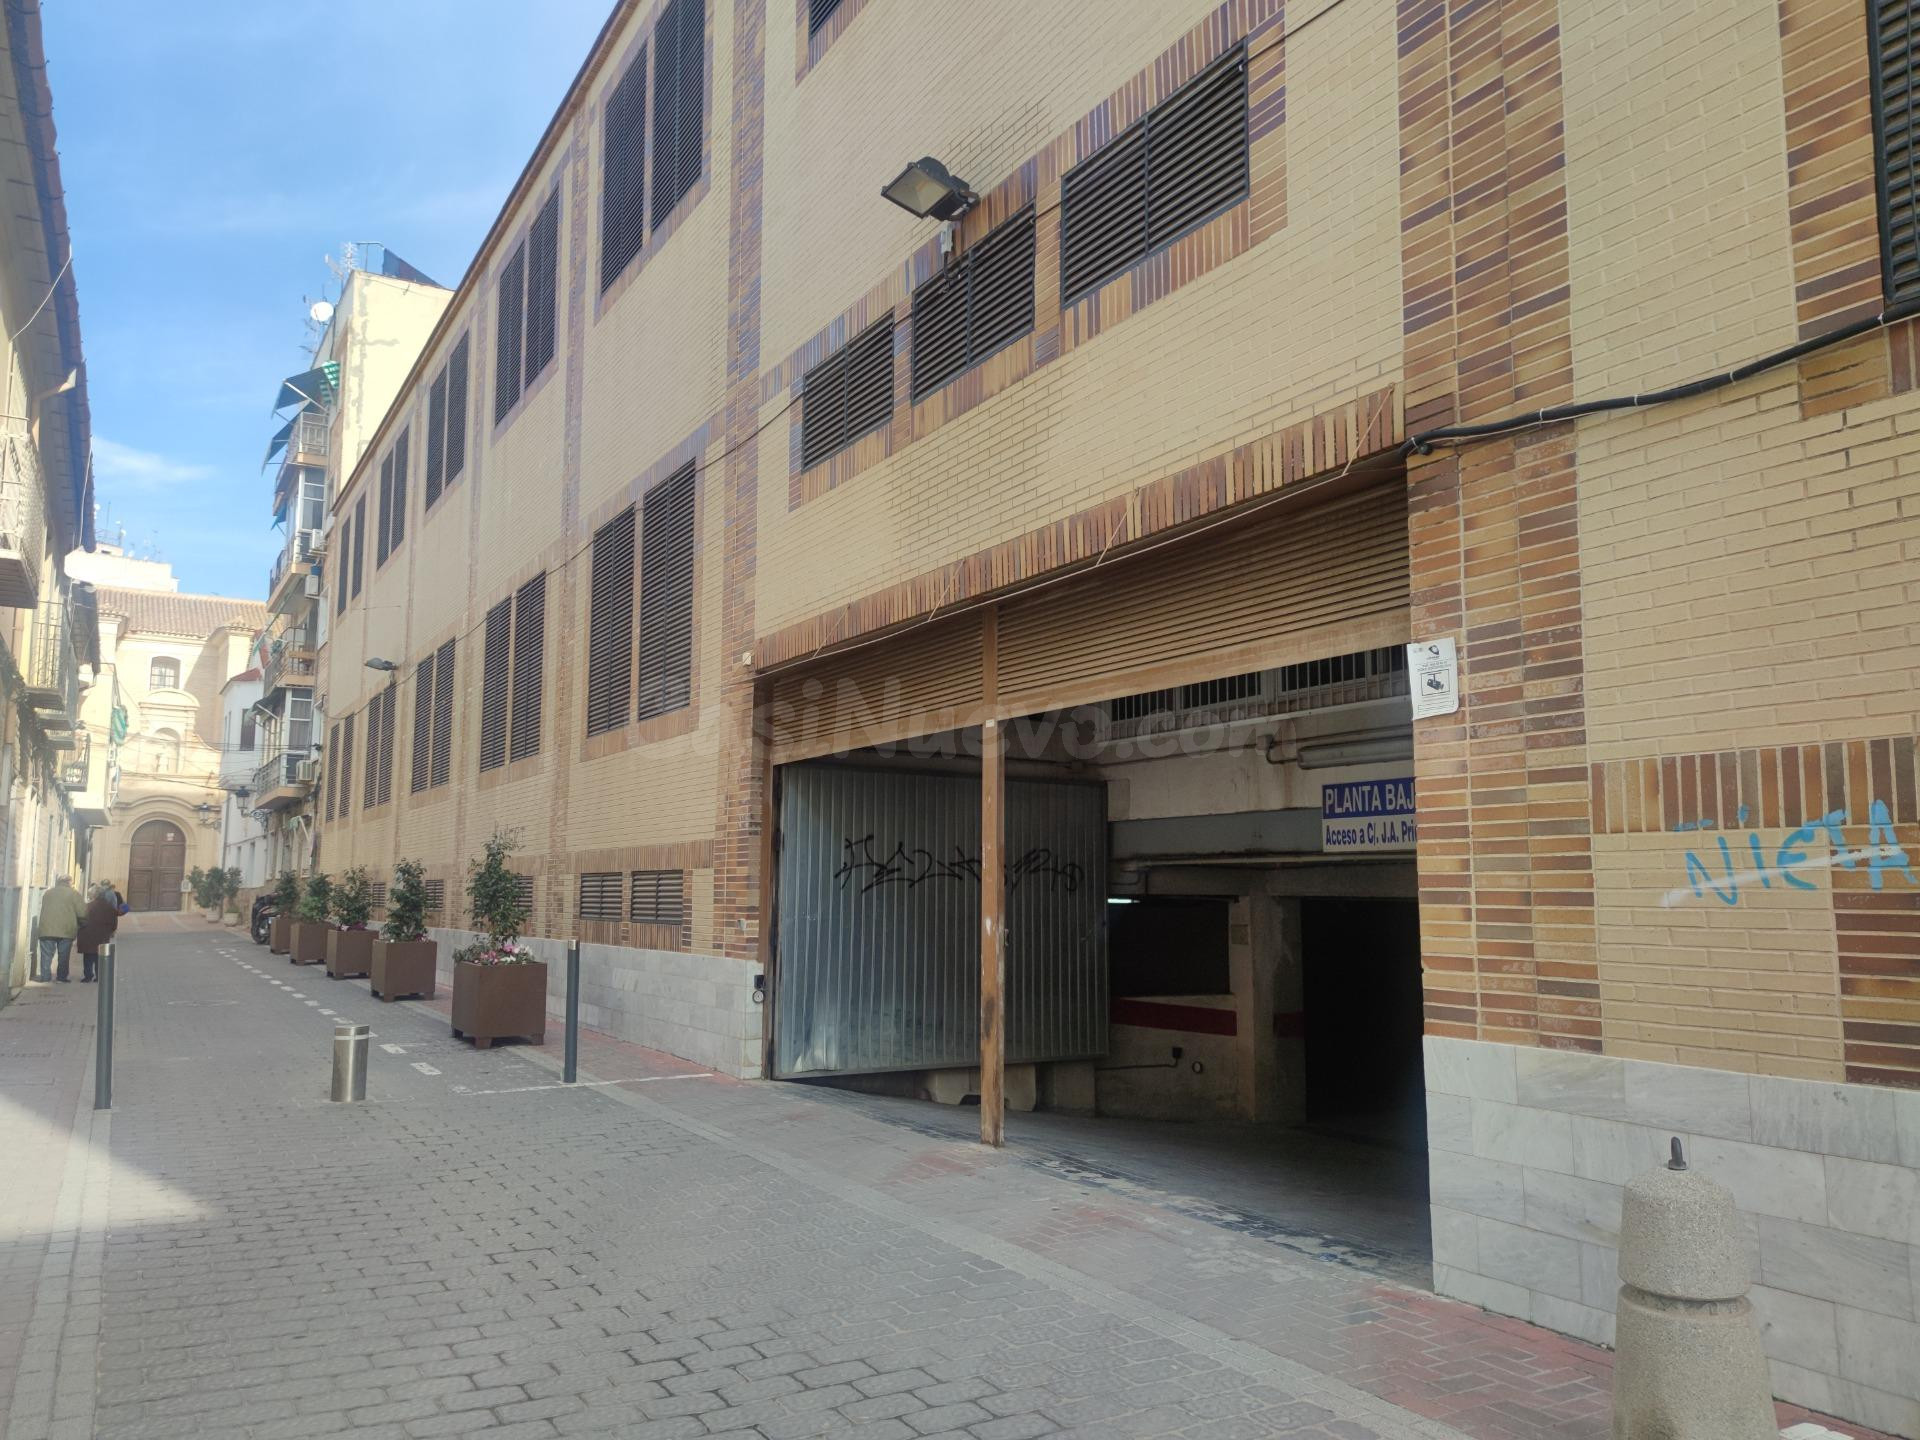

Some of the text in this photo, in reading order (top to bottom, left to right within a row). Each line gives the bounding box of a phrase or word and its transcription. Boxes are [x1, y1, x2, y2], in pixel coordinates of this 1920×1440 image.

[1325, 783, 1415, 814] PLANTA BAJ
[1326, 825, 1357, 846] Acceso
[1359, 829, 1366, 844] a
[1381, 821, 1399, 844] J.A.
[1401, 819, 1417, 843] Pri
